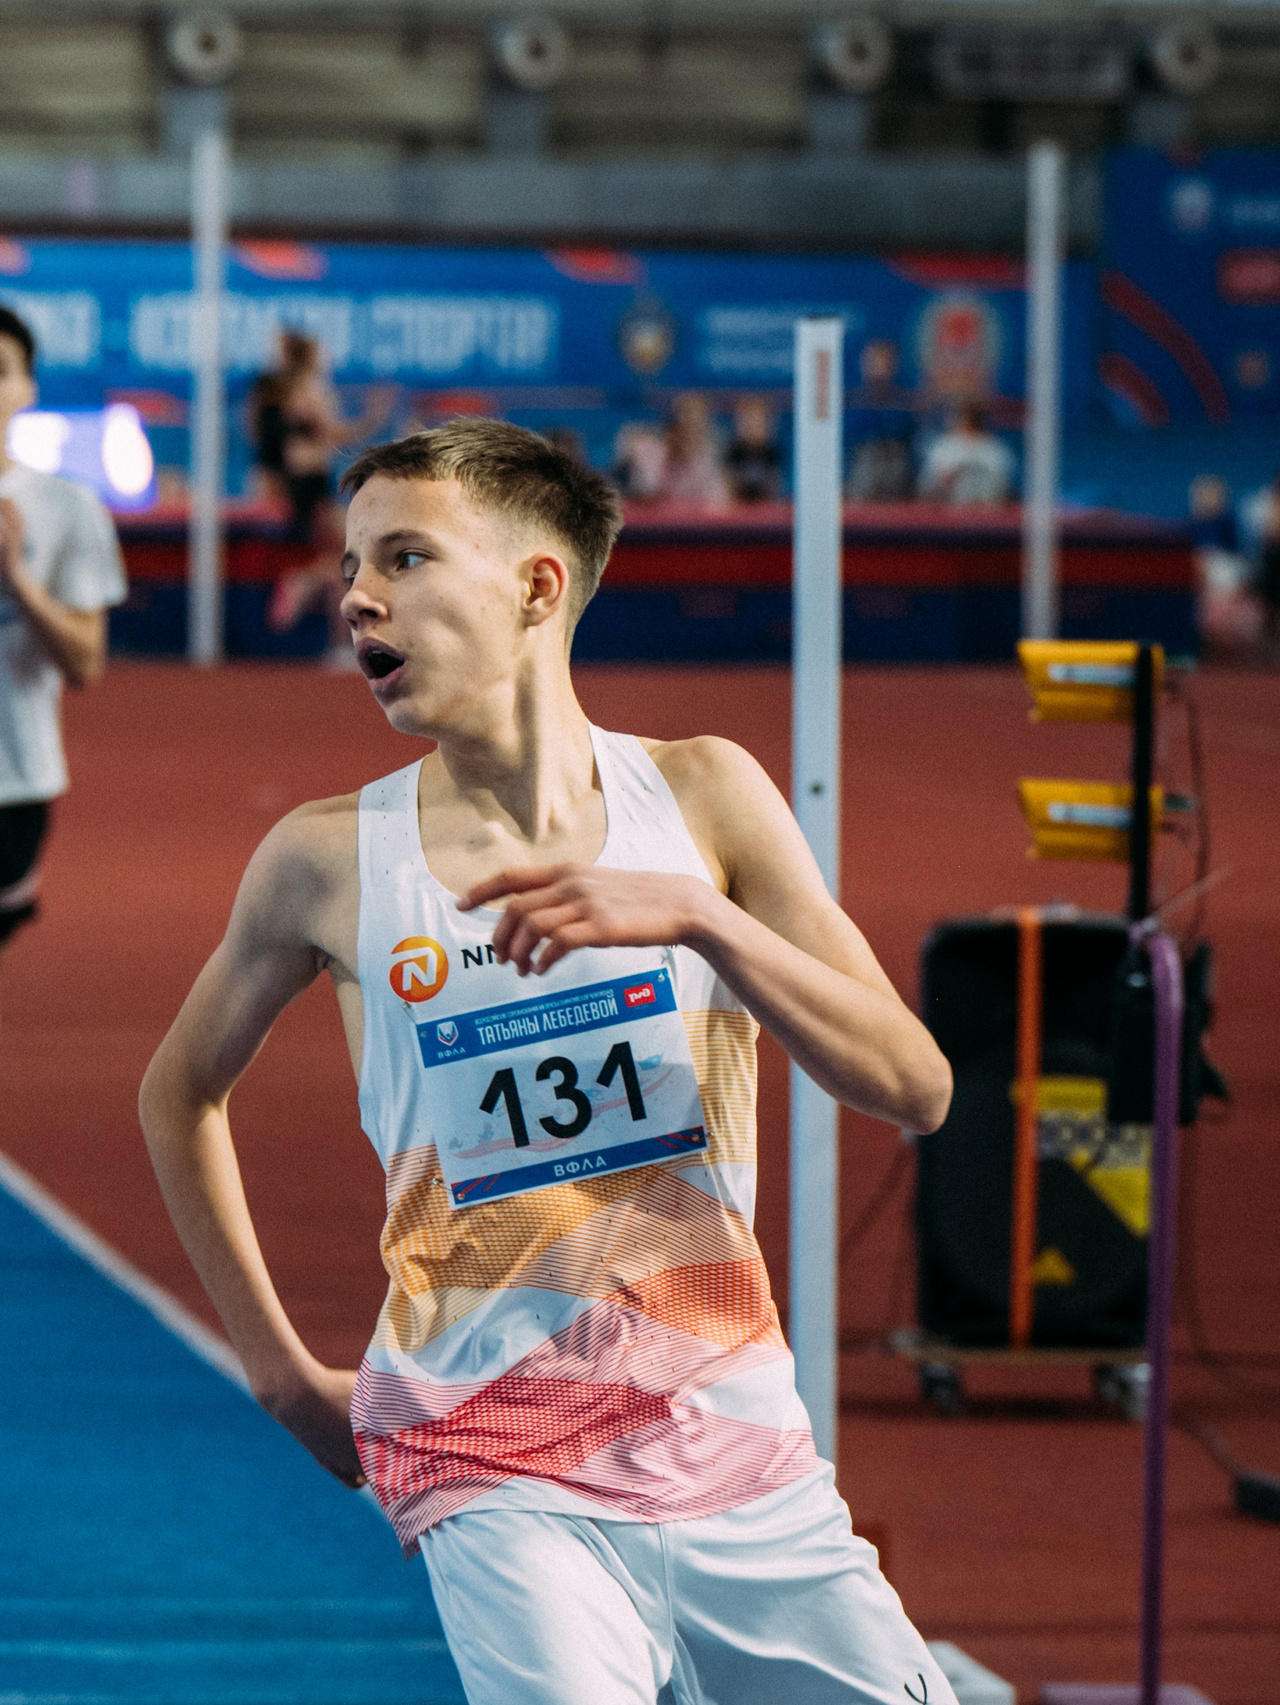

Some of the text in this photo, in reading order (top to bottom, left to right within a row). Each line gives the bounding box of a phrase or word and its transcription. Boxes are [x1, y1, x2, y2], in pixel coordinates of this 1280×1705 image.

[477, 1015, 540, 1045] ТАТЬЯНЫ
[542, 994, 619, 1031] ЛЕБЕДЕВОЙ
[438, 1047, 466, 1059] ВФЛА
[479, 1041, 647, 1148] 131
[553, 1155, 607, 1177] ВФЛА
